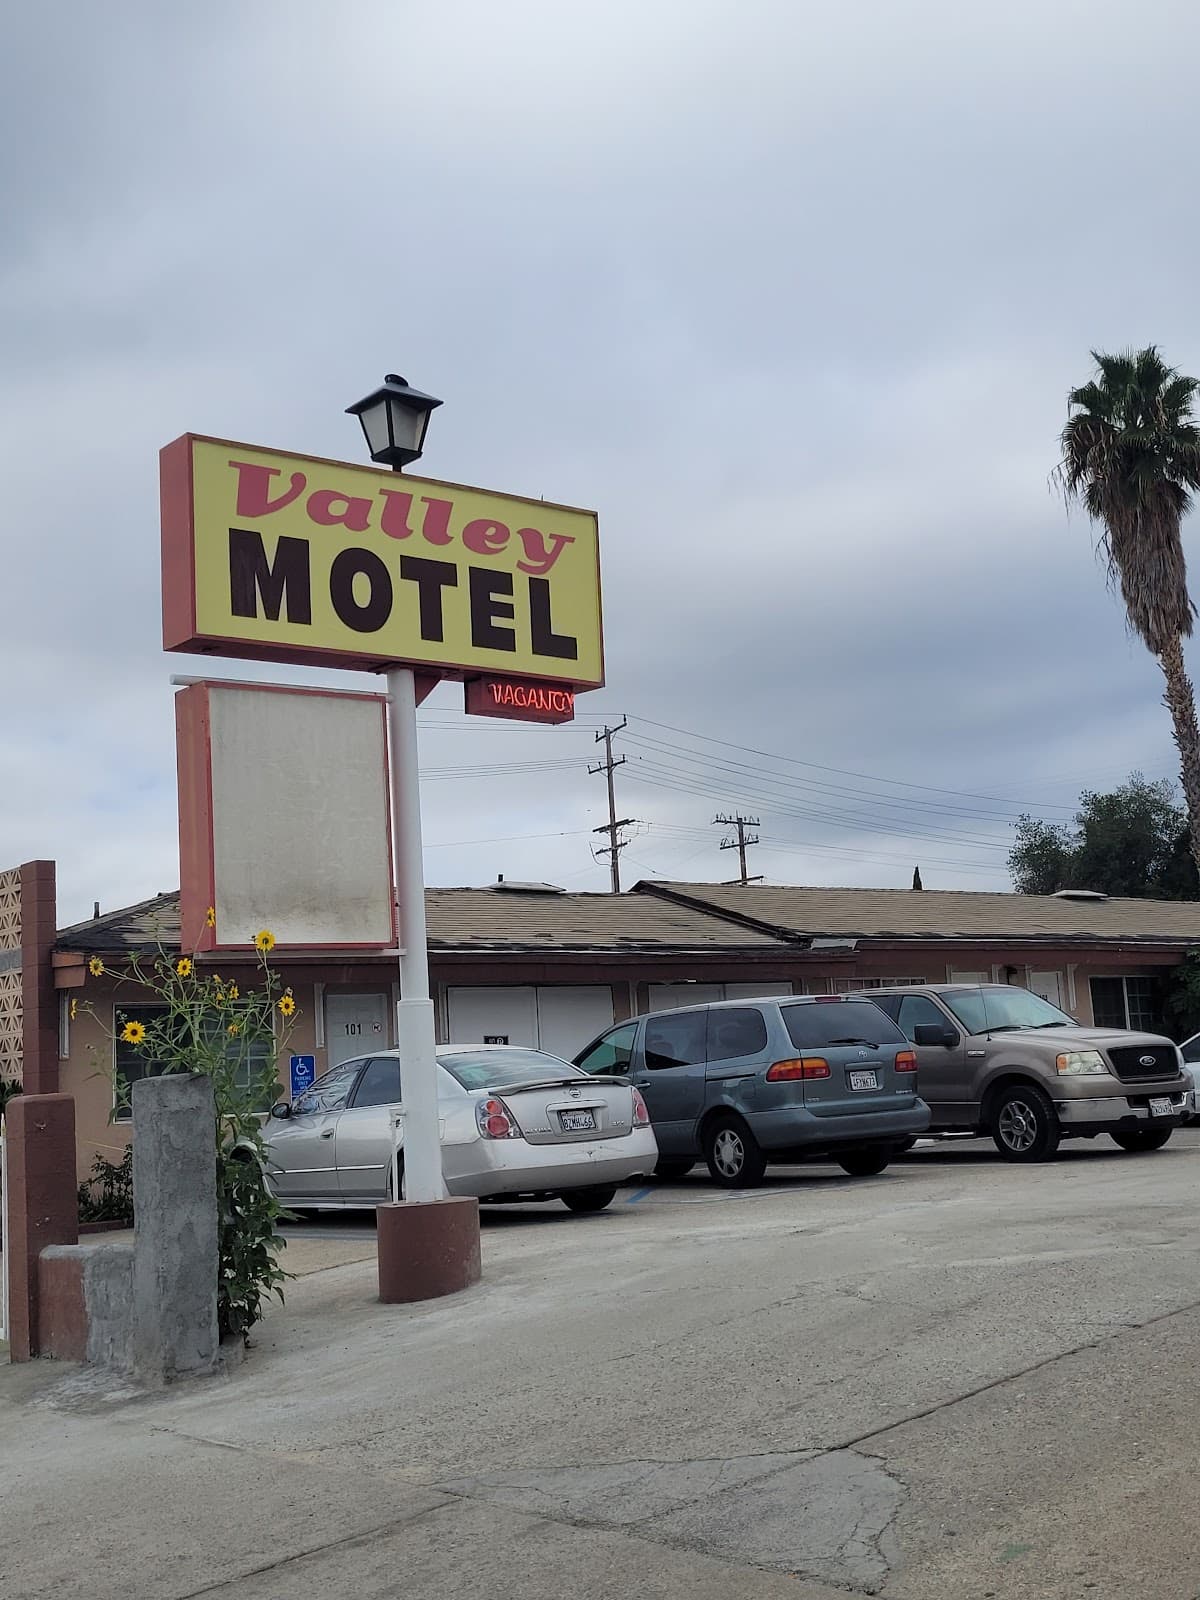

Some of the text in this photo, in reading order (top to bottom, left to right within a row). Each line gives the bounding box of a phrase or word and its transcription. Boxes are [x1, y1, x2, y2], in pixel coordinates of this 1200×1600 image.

[228, 460, 576, 575] Valley
[228, 527, 578, 660] MOTEL
[488, 683, 575, 713] VACANCY
[345, 1023, 361, 1035] 101
